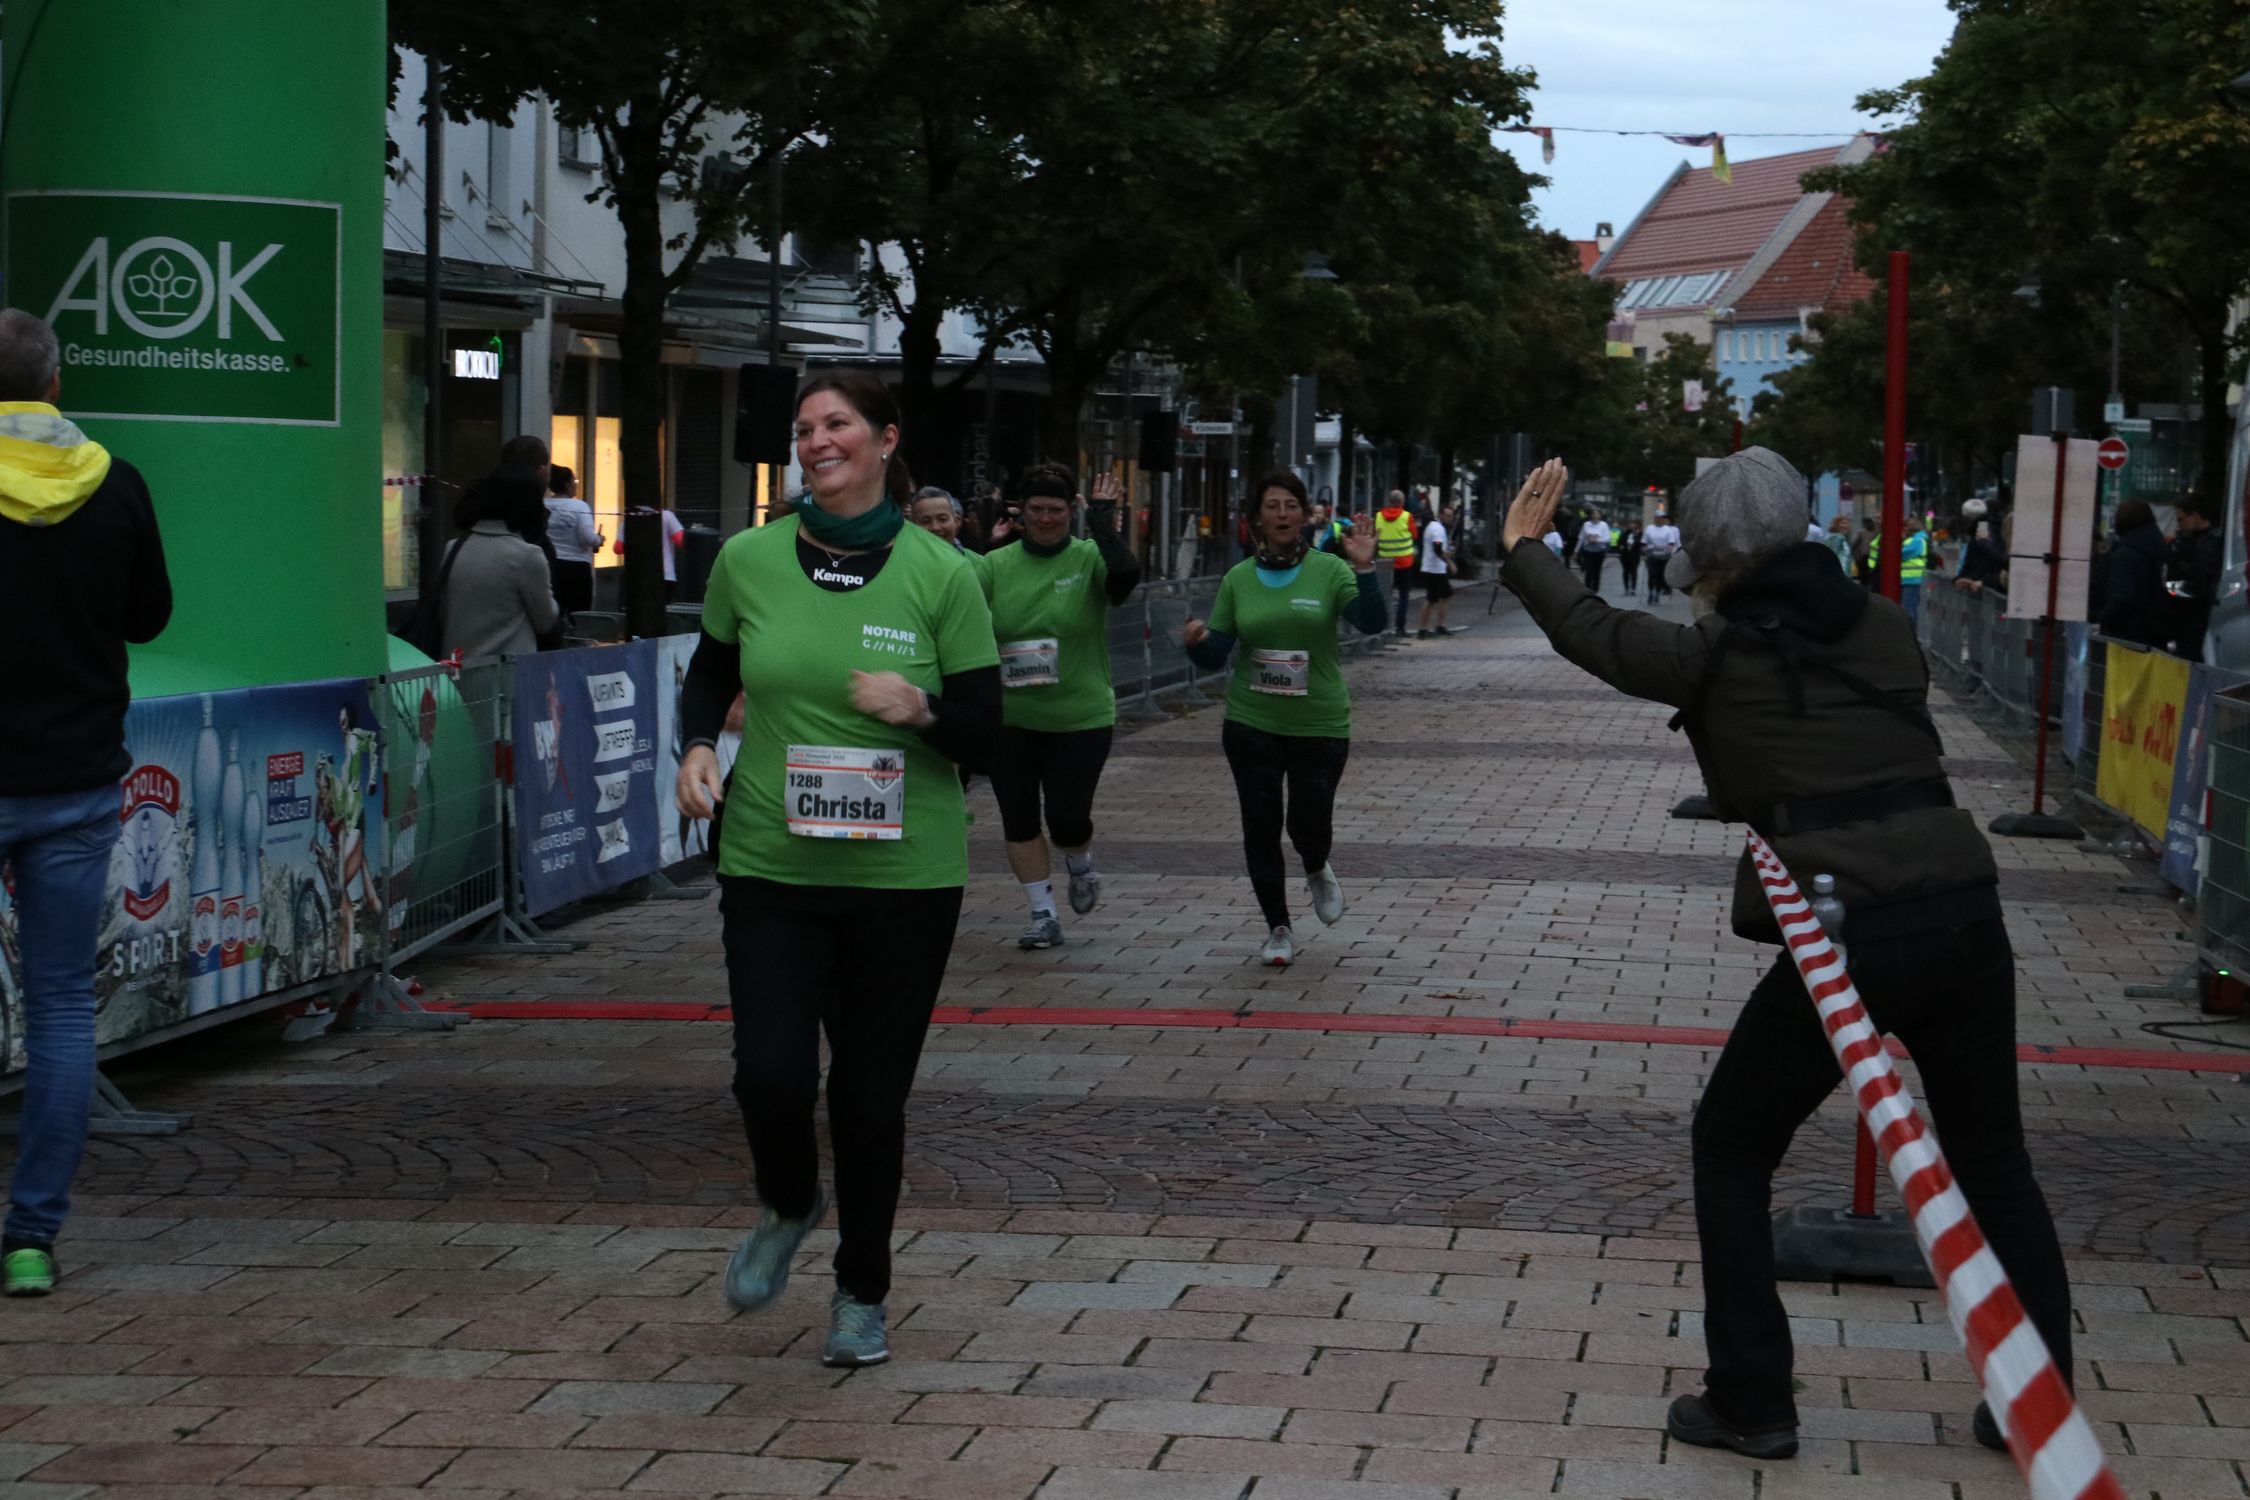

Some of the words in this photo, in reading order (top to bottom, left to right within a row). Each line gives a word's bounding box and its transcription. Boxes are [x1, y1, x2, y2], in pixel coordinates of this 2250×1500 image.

[46, 236, 285, 342] AOK
[64, 343, 291, 373] Gesundheitskasse.
[813, 568, 864, 587] Kempa
[863, 624, 917, 644] NOTARE
[863, 639, 871, 649] G
[887, 643, 895, 653] H
[910, 646, 917, 657] S
[1006, 664, 1051, 679] Jasmin
[1260, 671, 1292, 687] Viola
[789, 773, 823, 789] 1288
[123, 771, 174, 815] APOLLO
[797, 793, 886, 821] Christa
